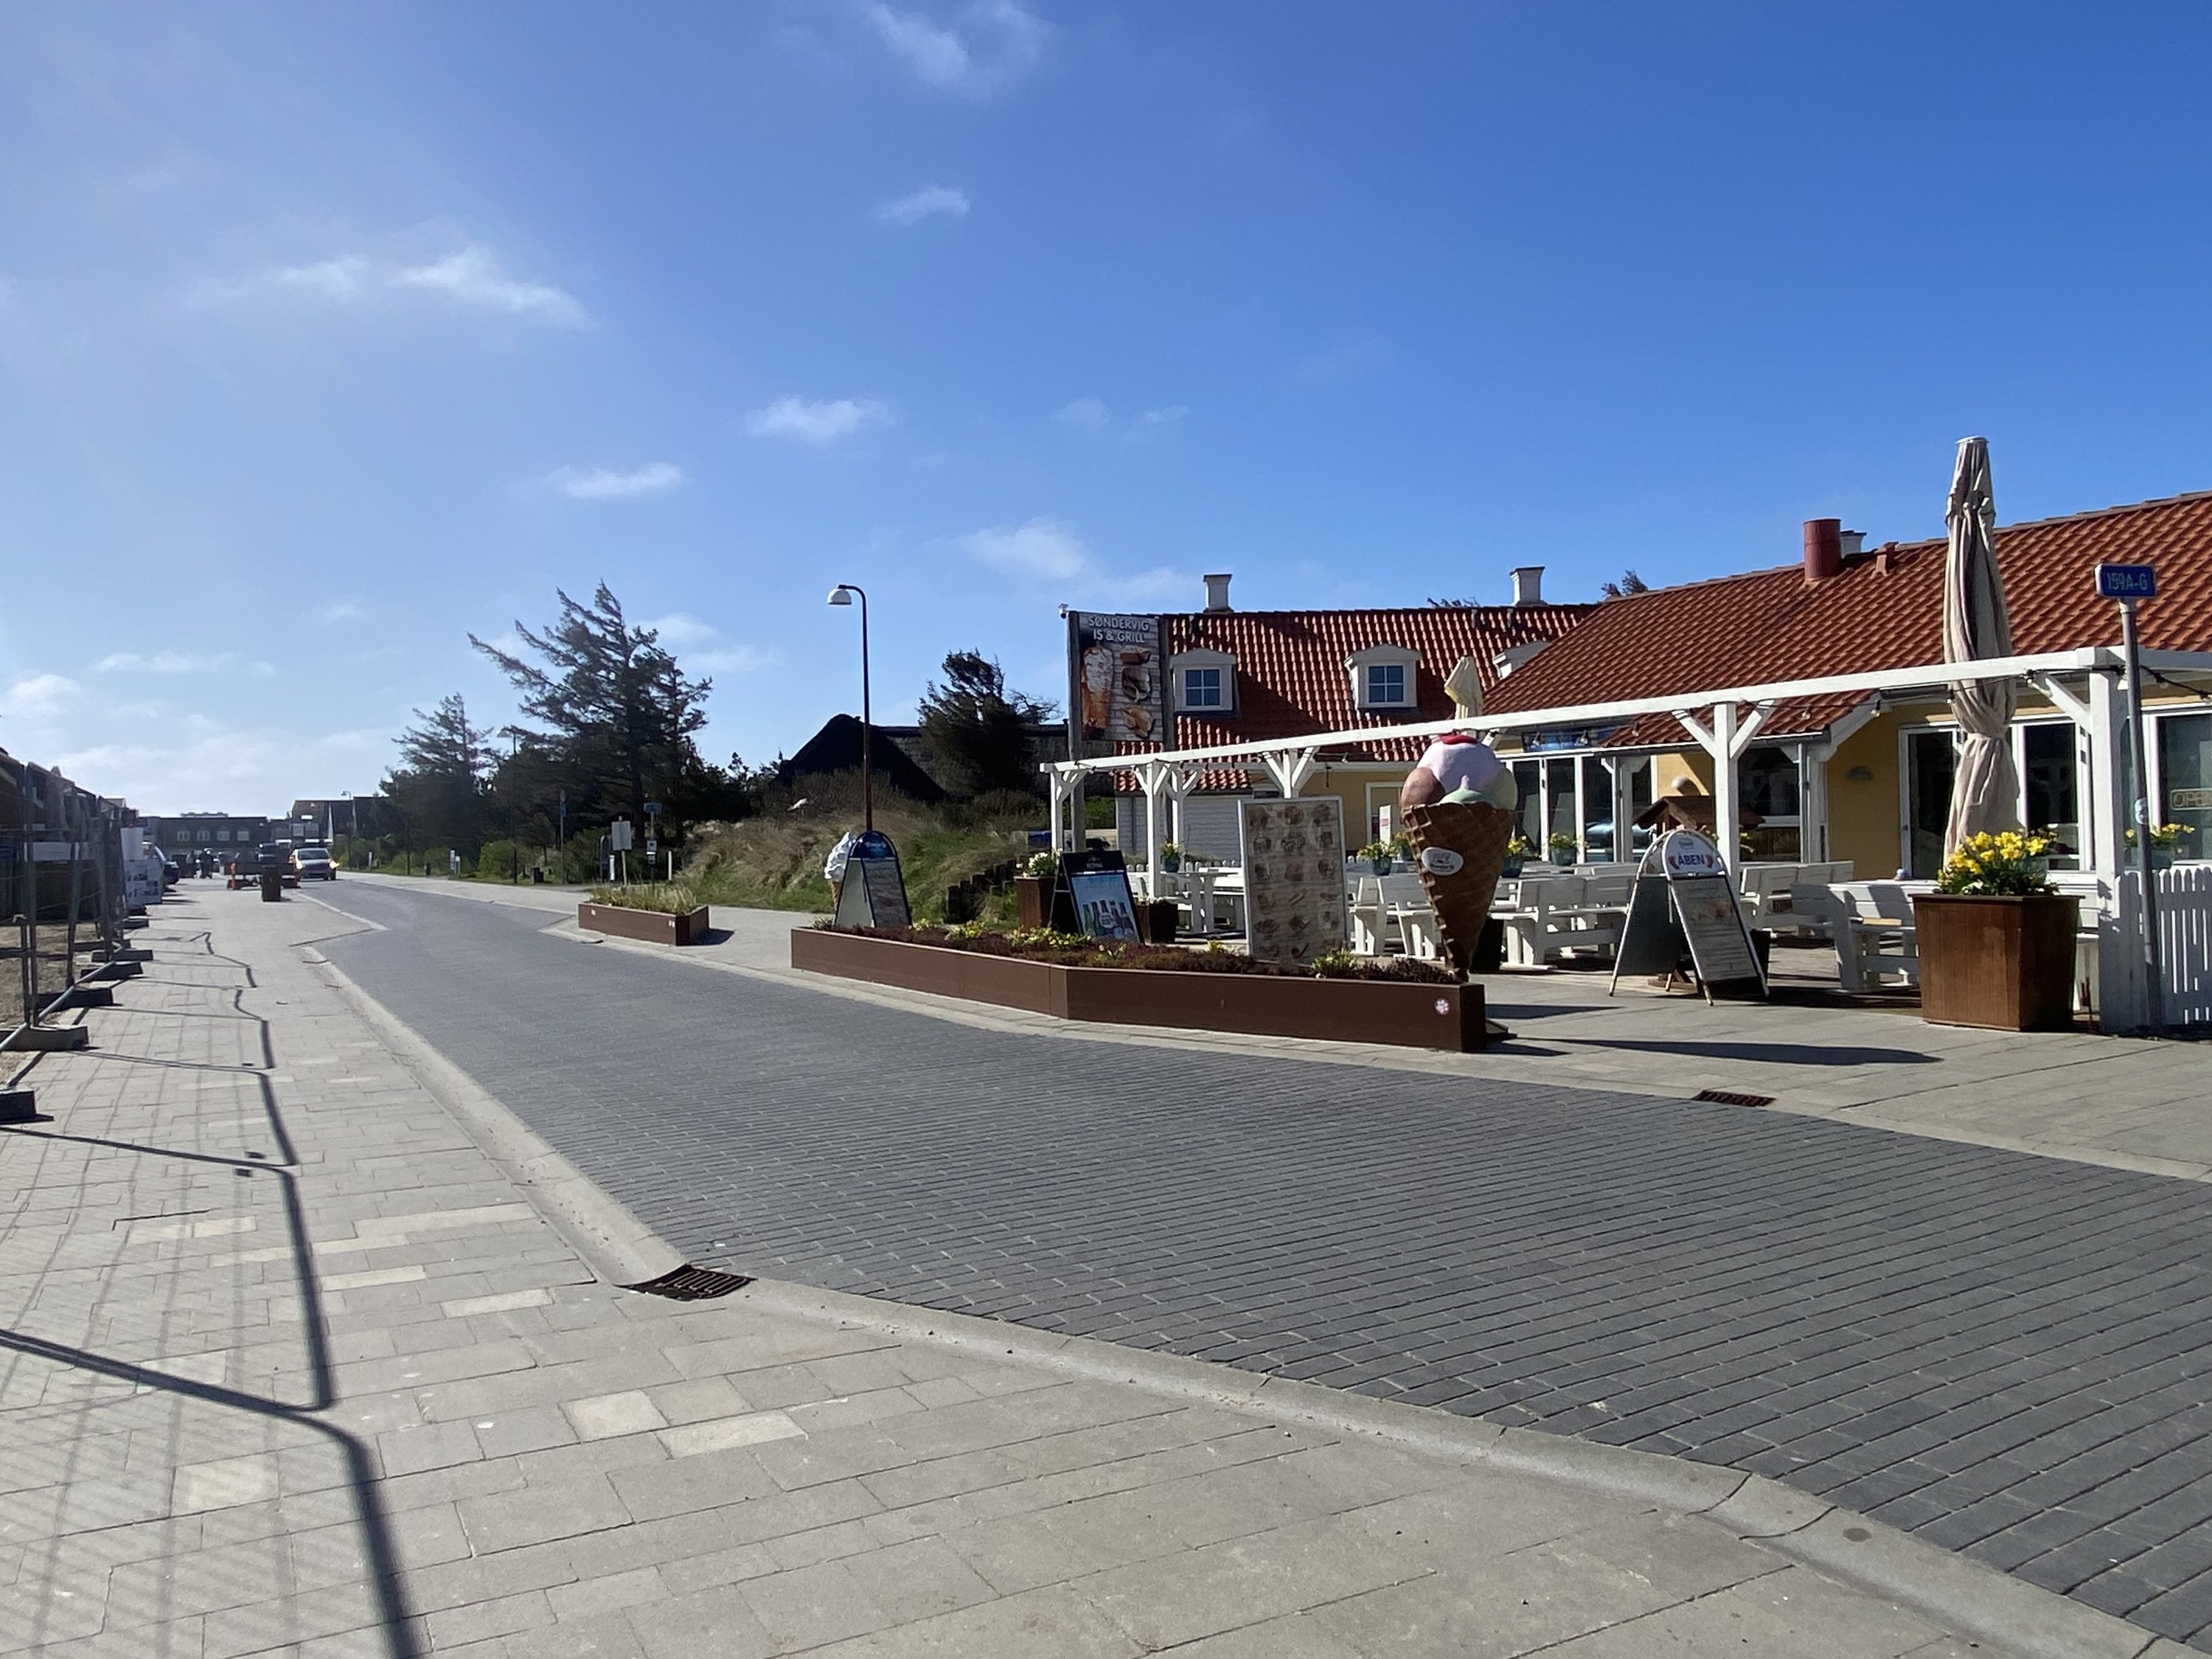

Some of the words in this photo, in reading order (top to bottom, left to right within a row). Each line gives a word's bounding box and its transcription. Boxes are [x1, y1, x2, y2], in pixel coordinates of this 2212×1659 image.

[1088, 615, 1148, 631] SØNDERVIG
[1093, 628, 1103, 641] IS
[1106, 630, 1114, 641] &
[1118, 631, 1145, 643] GRILL
